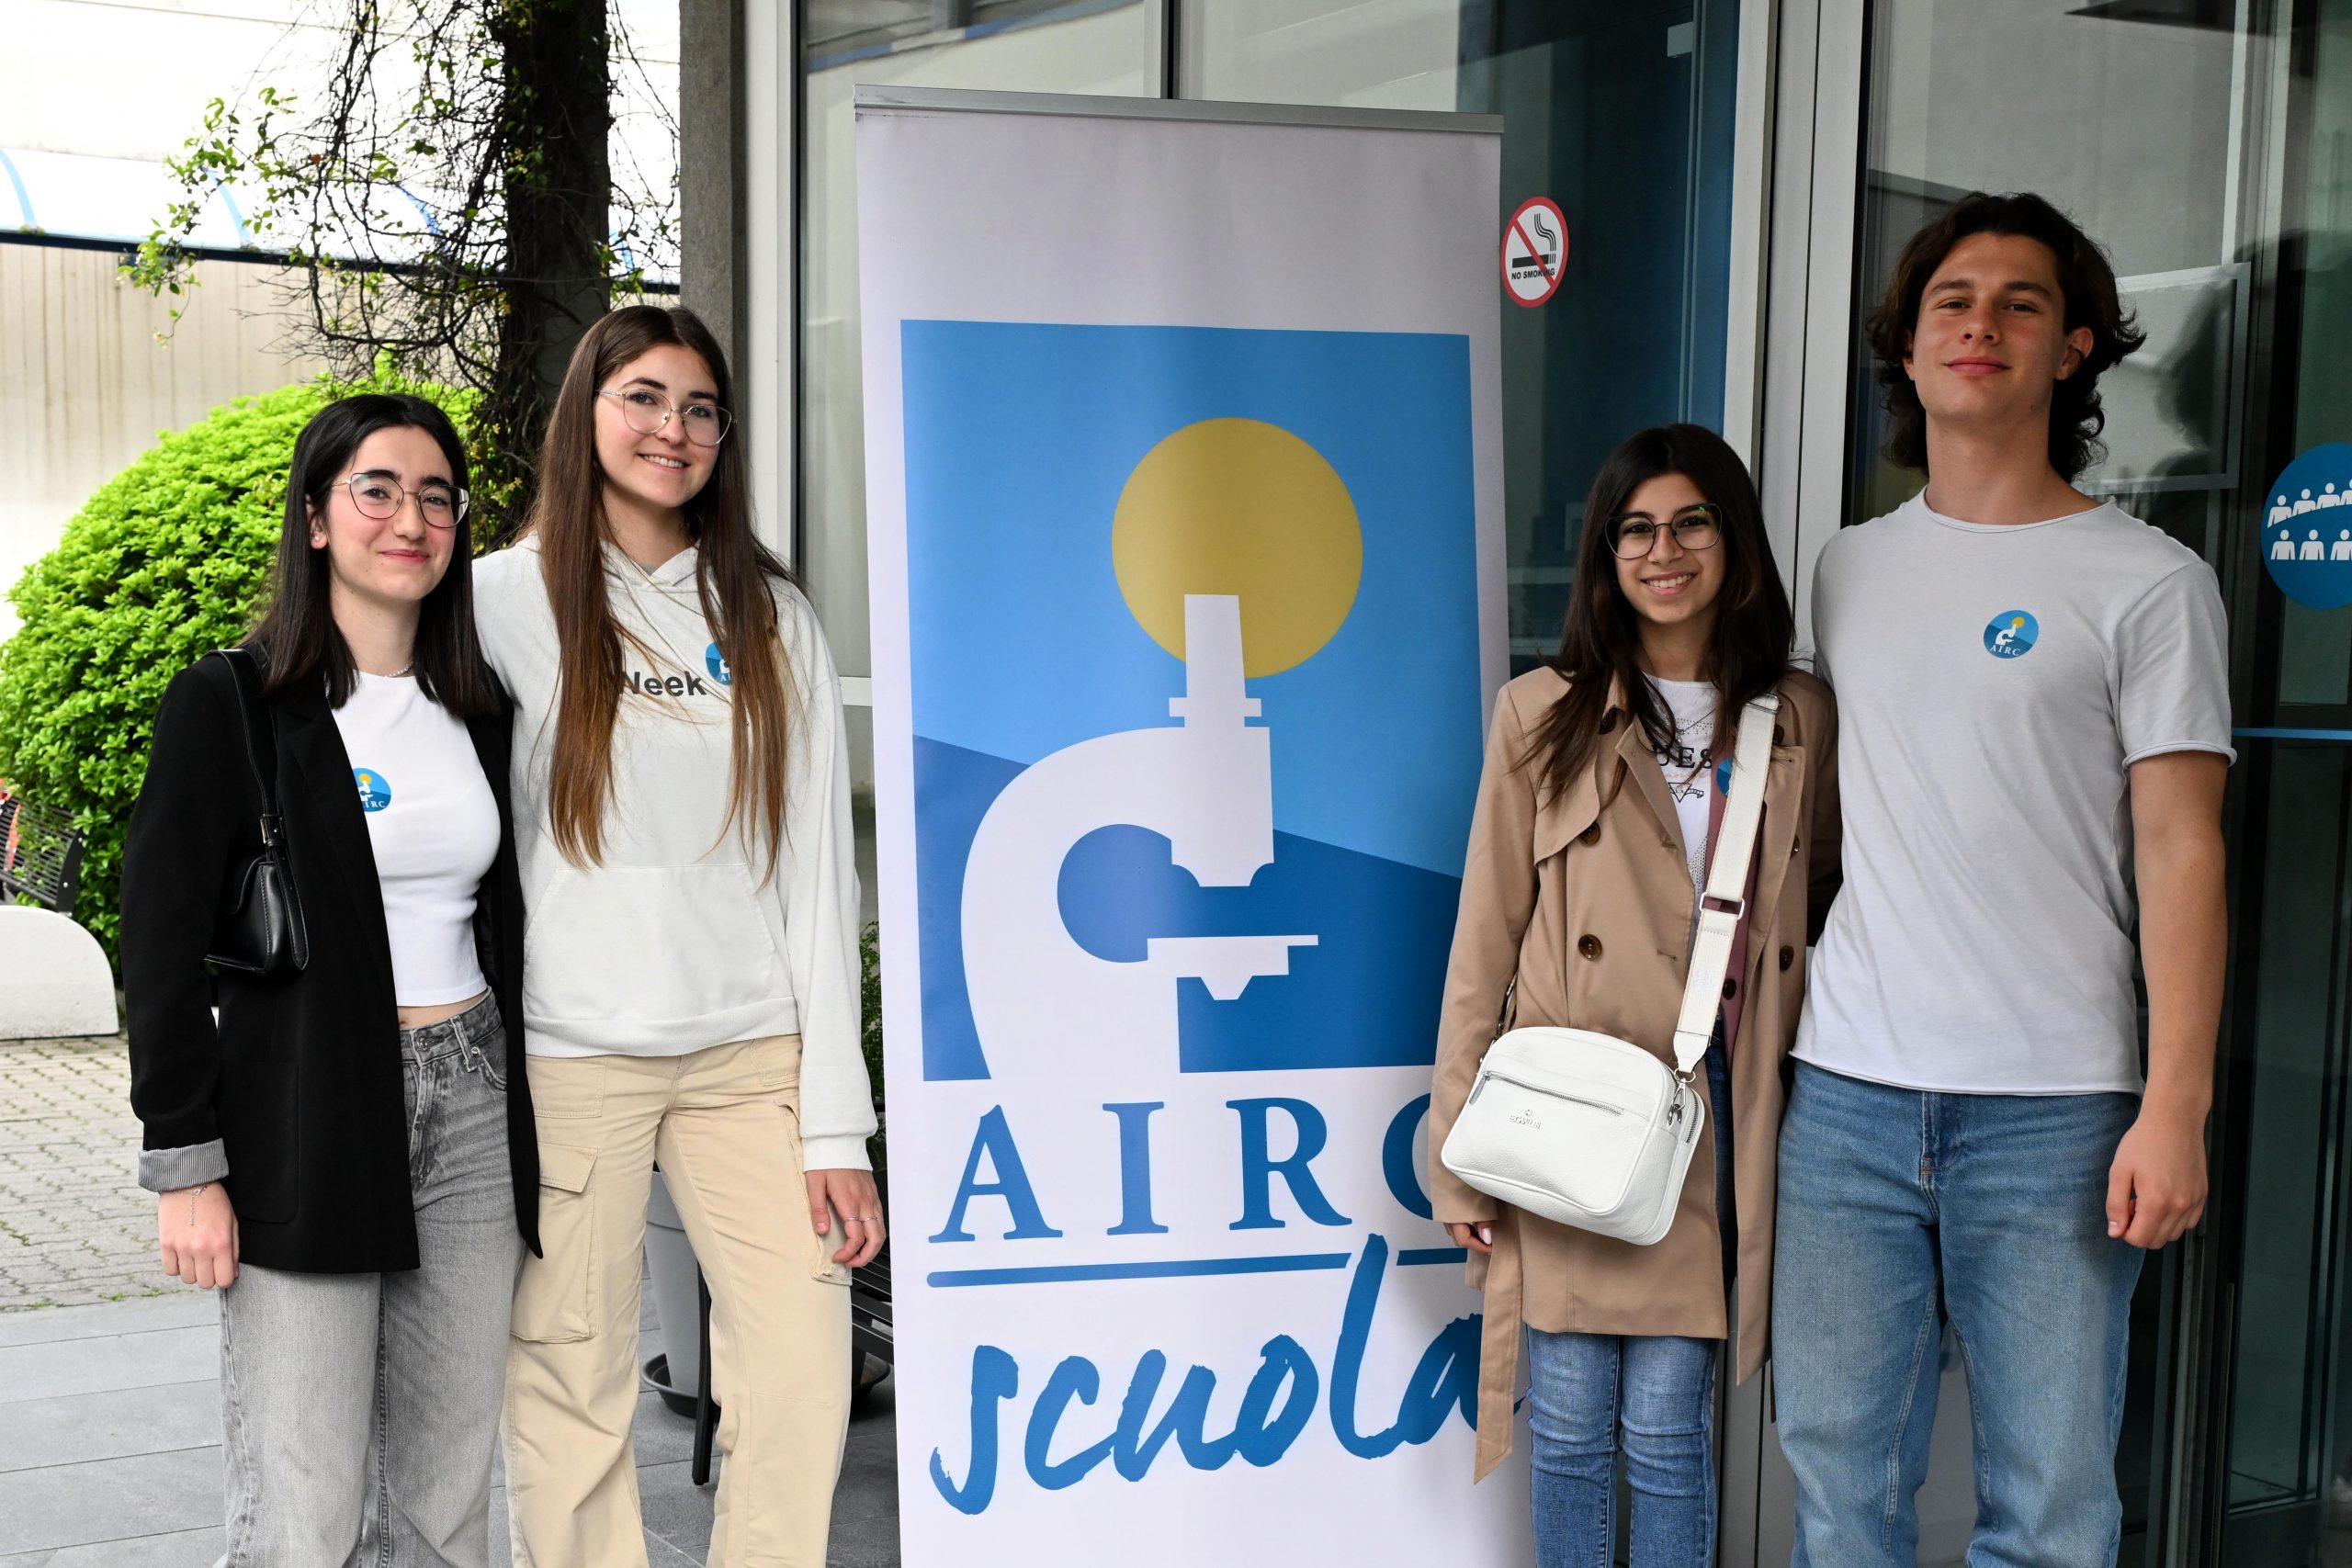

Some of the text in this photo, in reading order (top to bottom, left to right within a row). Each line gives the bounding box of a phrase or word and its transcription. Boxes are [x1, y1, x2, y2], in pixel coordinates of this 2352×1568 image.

[1511, 267, 1555, 280] NO SMOKING
[1989, 645, 2021, 657] AIRC
[365, 800, 386, 808] IRC
[929, 1234, 1526, 1515] scuola
